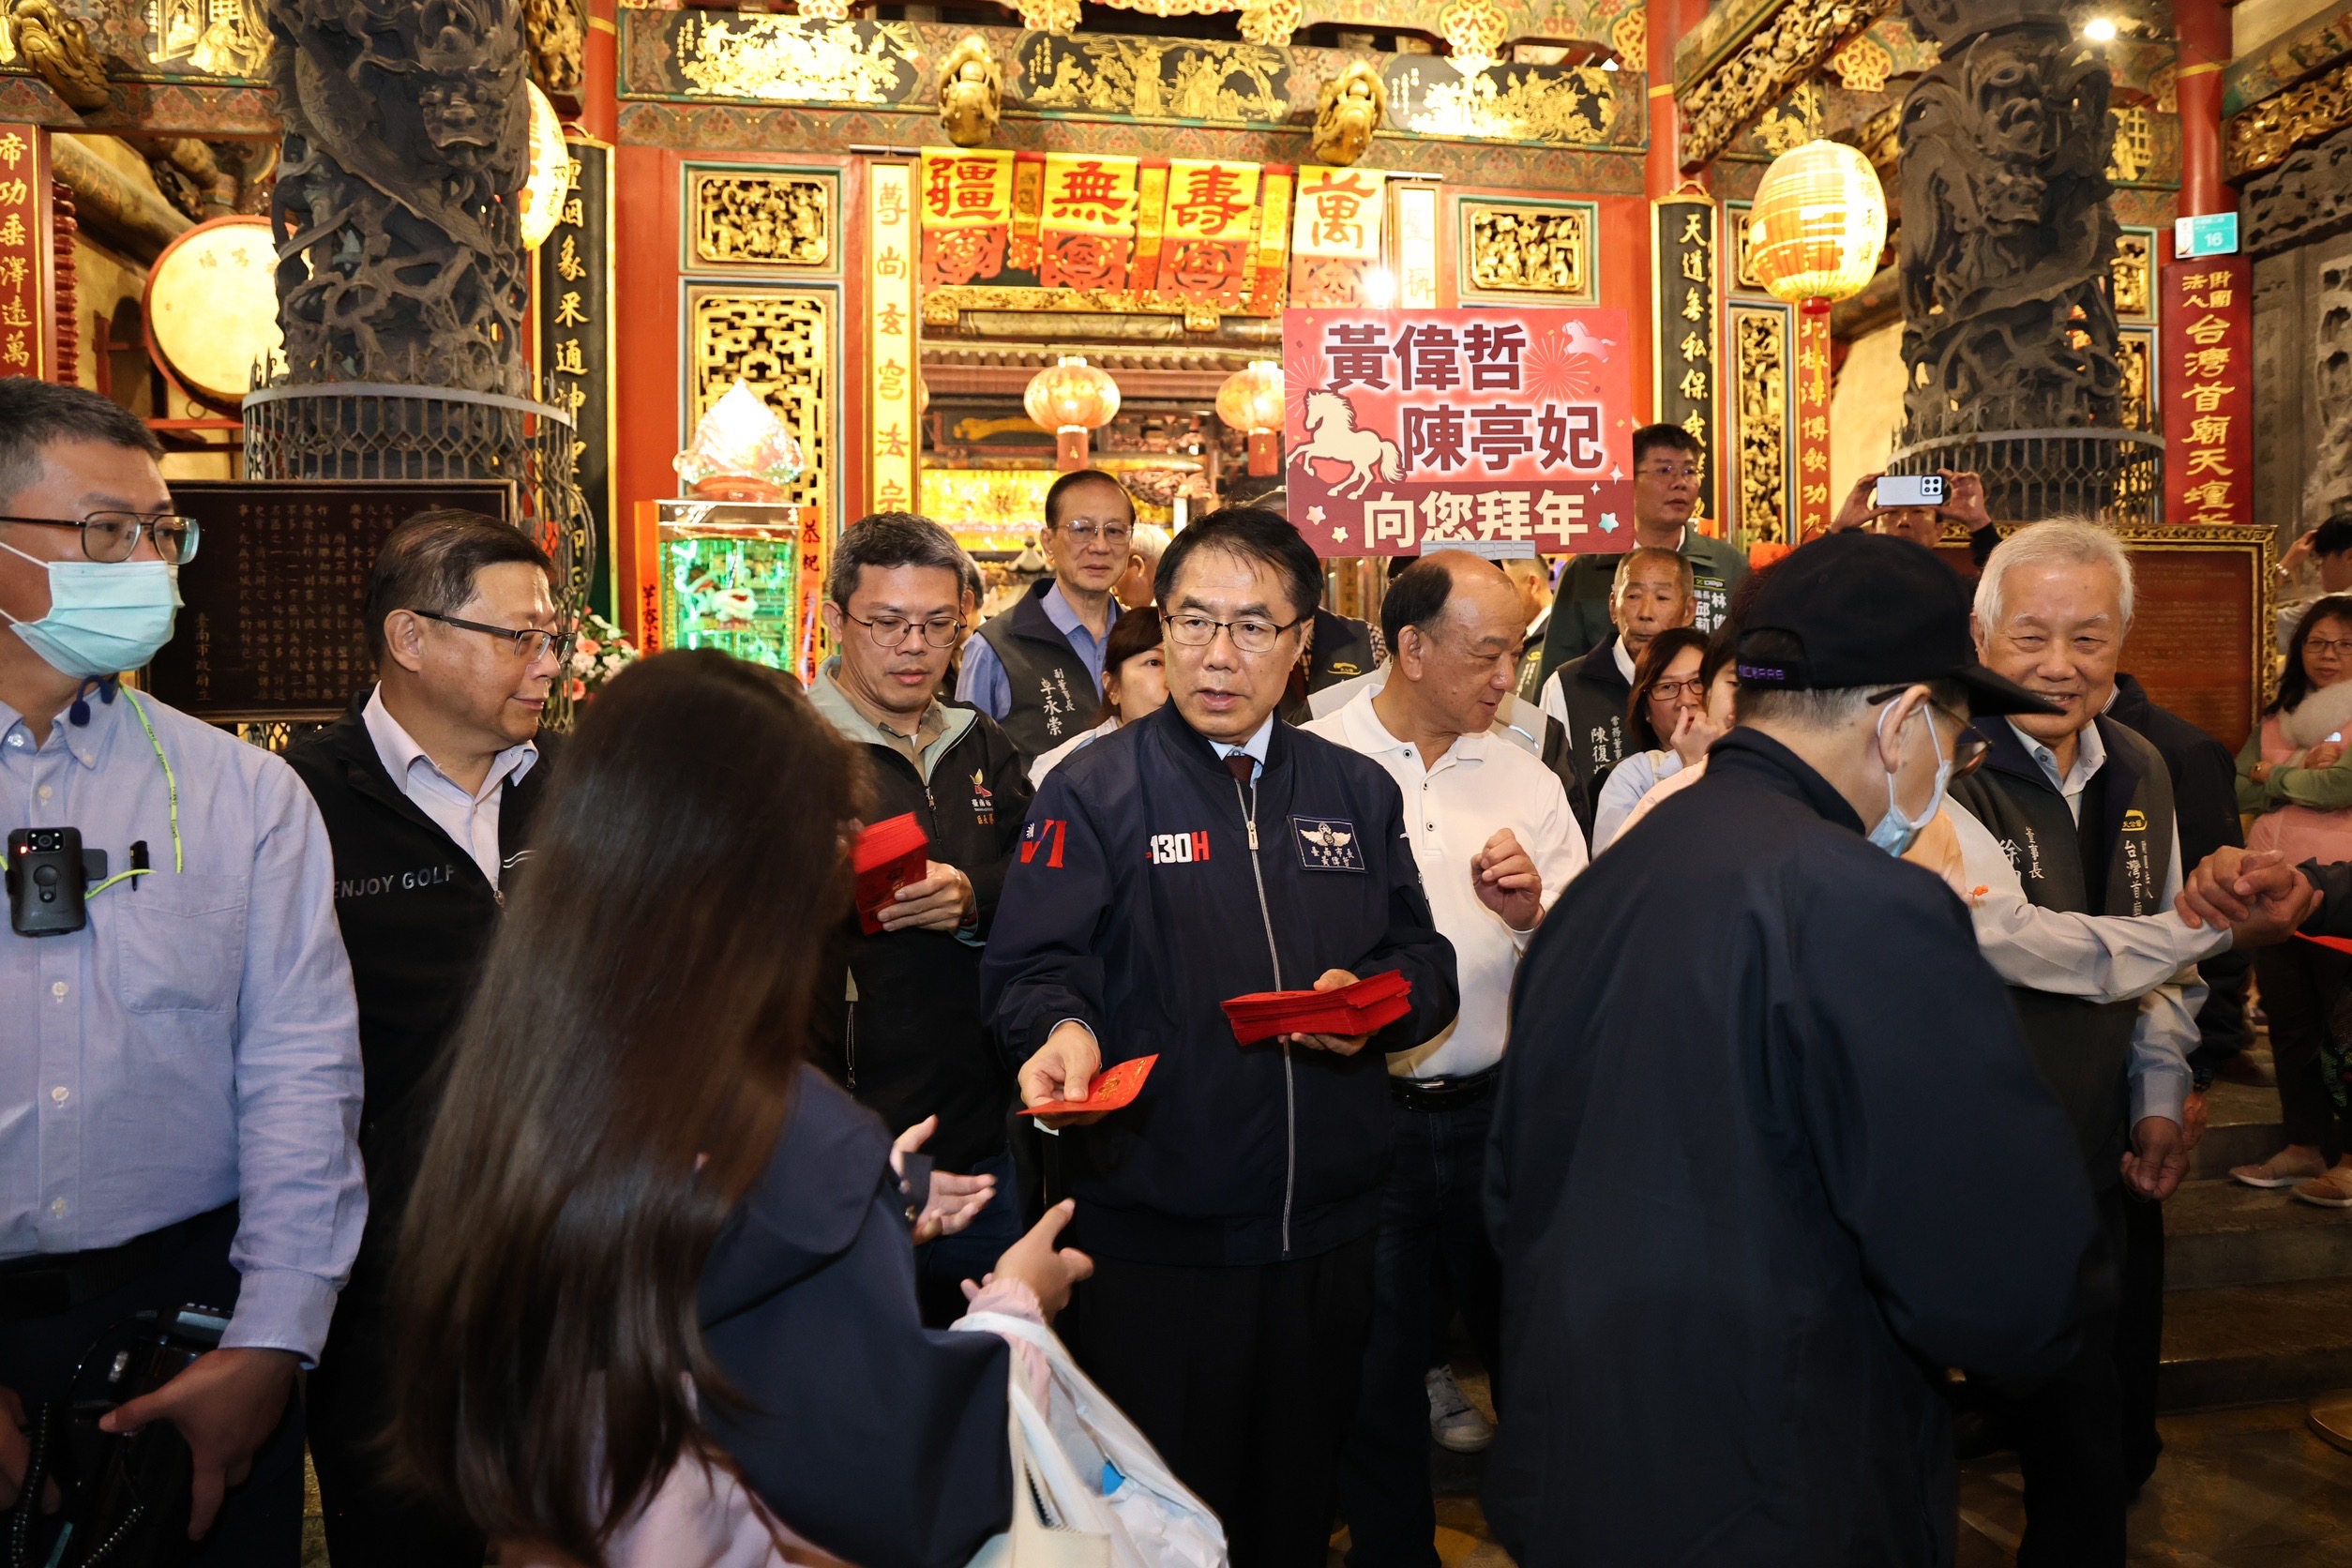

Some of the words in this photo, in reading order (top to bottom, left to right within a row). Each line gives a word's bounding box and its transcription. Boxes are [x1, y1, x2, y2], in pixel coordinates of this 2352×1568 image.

[0, 131, 33, 377] 帝功垂澤遠萬
[1325, 324, 1527, 392] 黃偉哲
[1402, 403, 1604, 472] 陳亭妃
[2180, 313, 2237, 525] 台灣首廟天壇
[1363, 489, 1589, 549] 向您拜年
[1040, 677, 1063, 736] 卓永崇
[334, 874, 395, 898] ENJOY
[401, 864, 455, 890] GOLF
